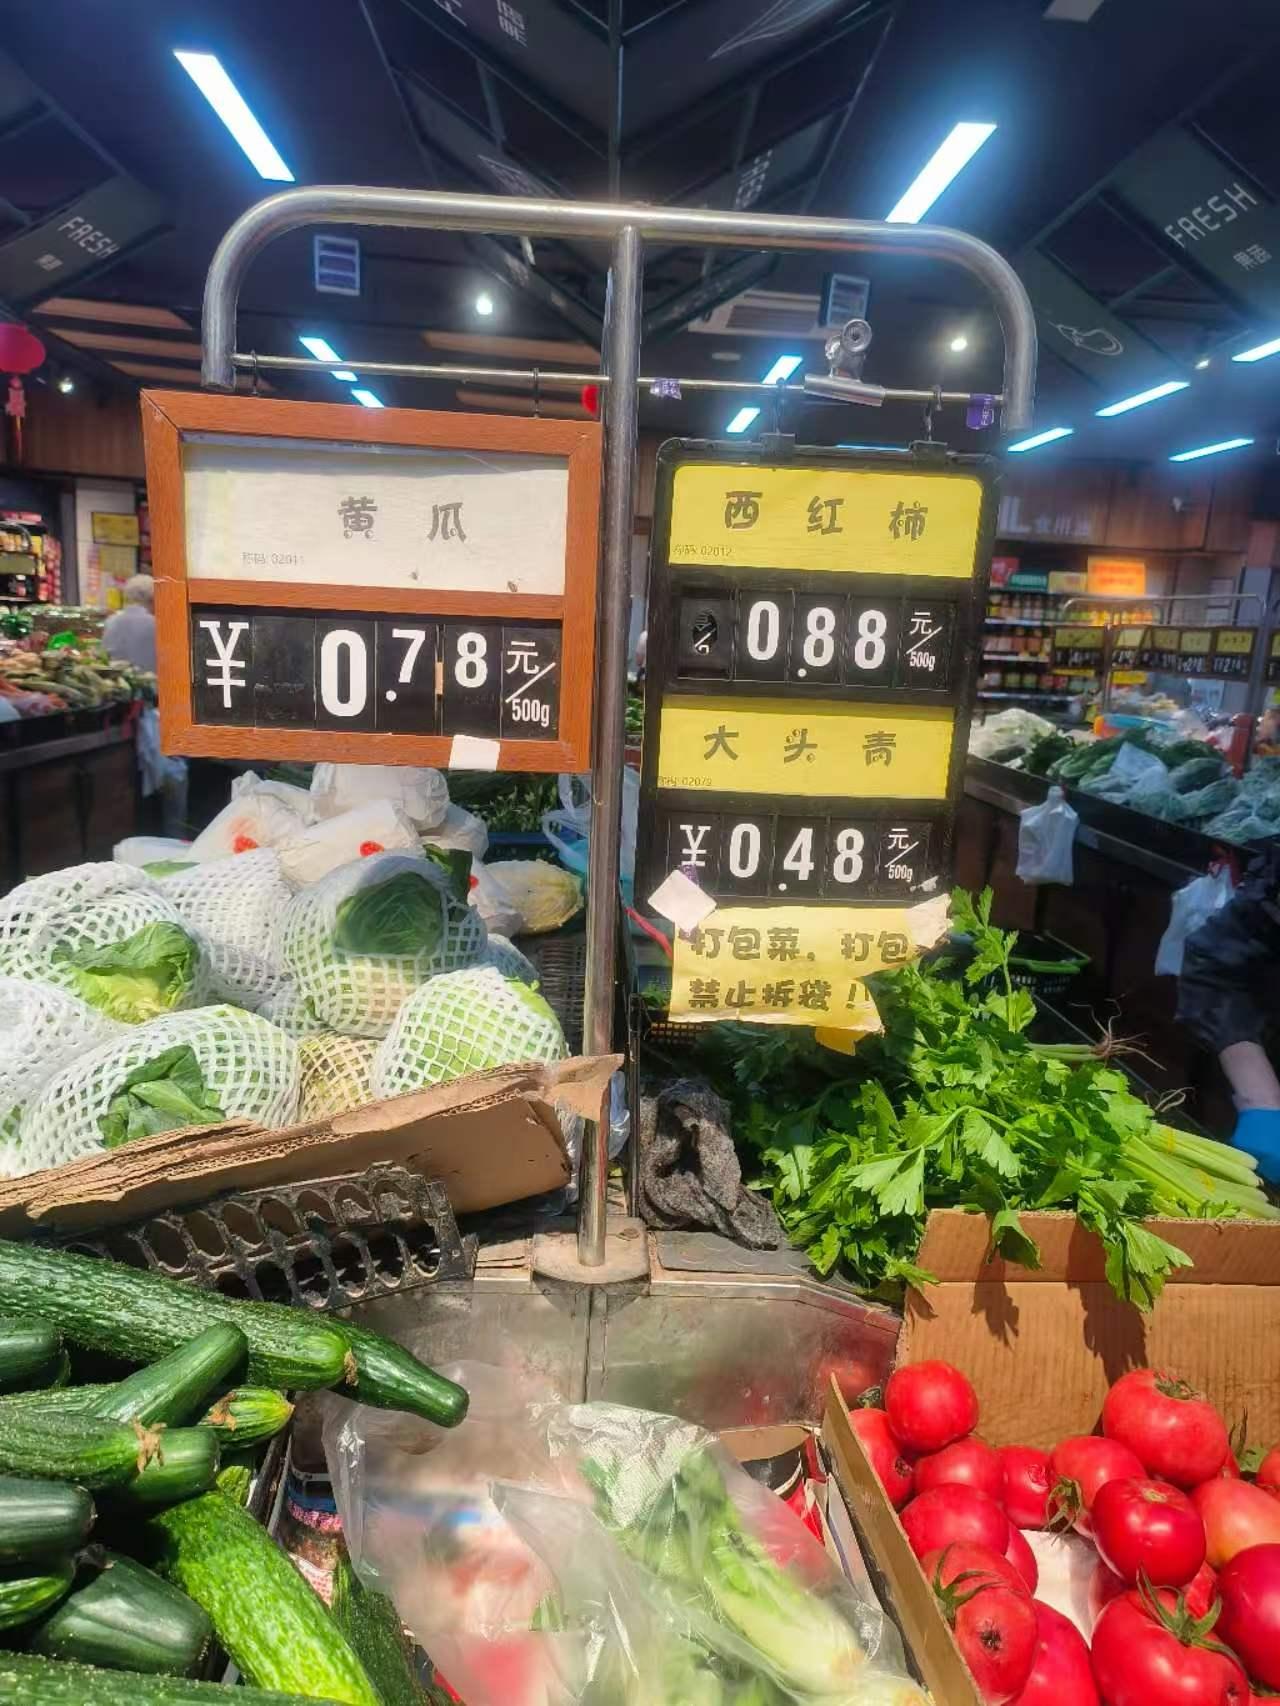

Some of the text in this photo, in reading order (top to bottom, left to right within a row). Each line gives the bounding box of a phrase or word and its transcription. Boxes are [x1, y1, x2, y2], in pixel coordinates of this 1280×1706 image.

[337, 496, 467, 542] 黄瓜
[724, 491, 929, 540] 西红柿
[747, 600, 887, 678] 0.88
[703, 725, 897, 767] 大头青
